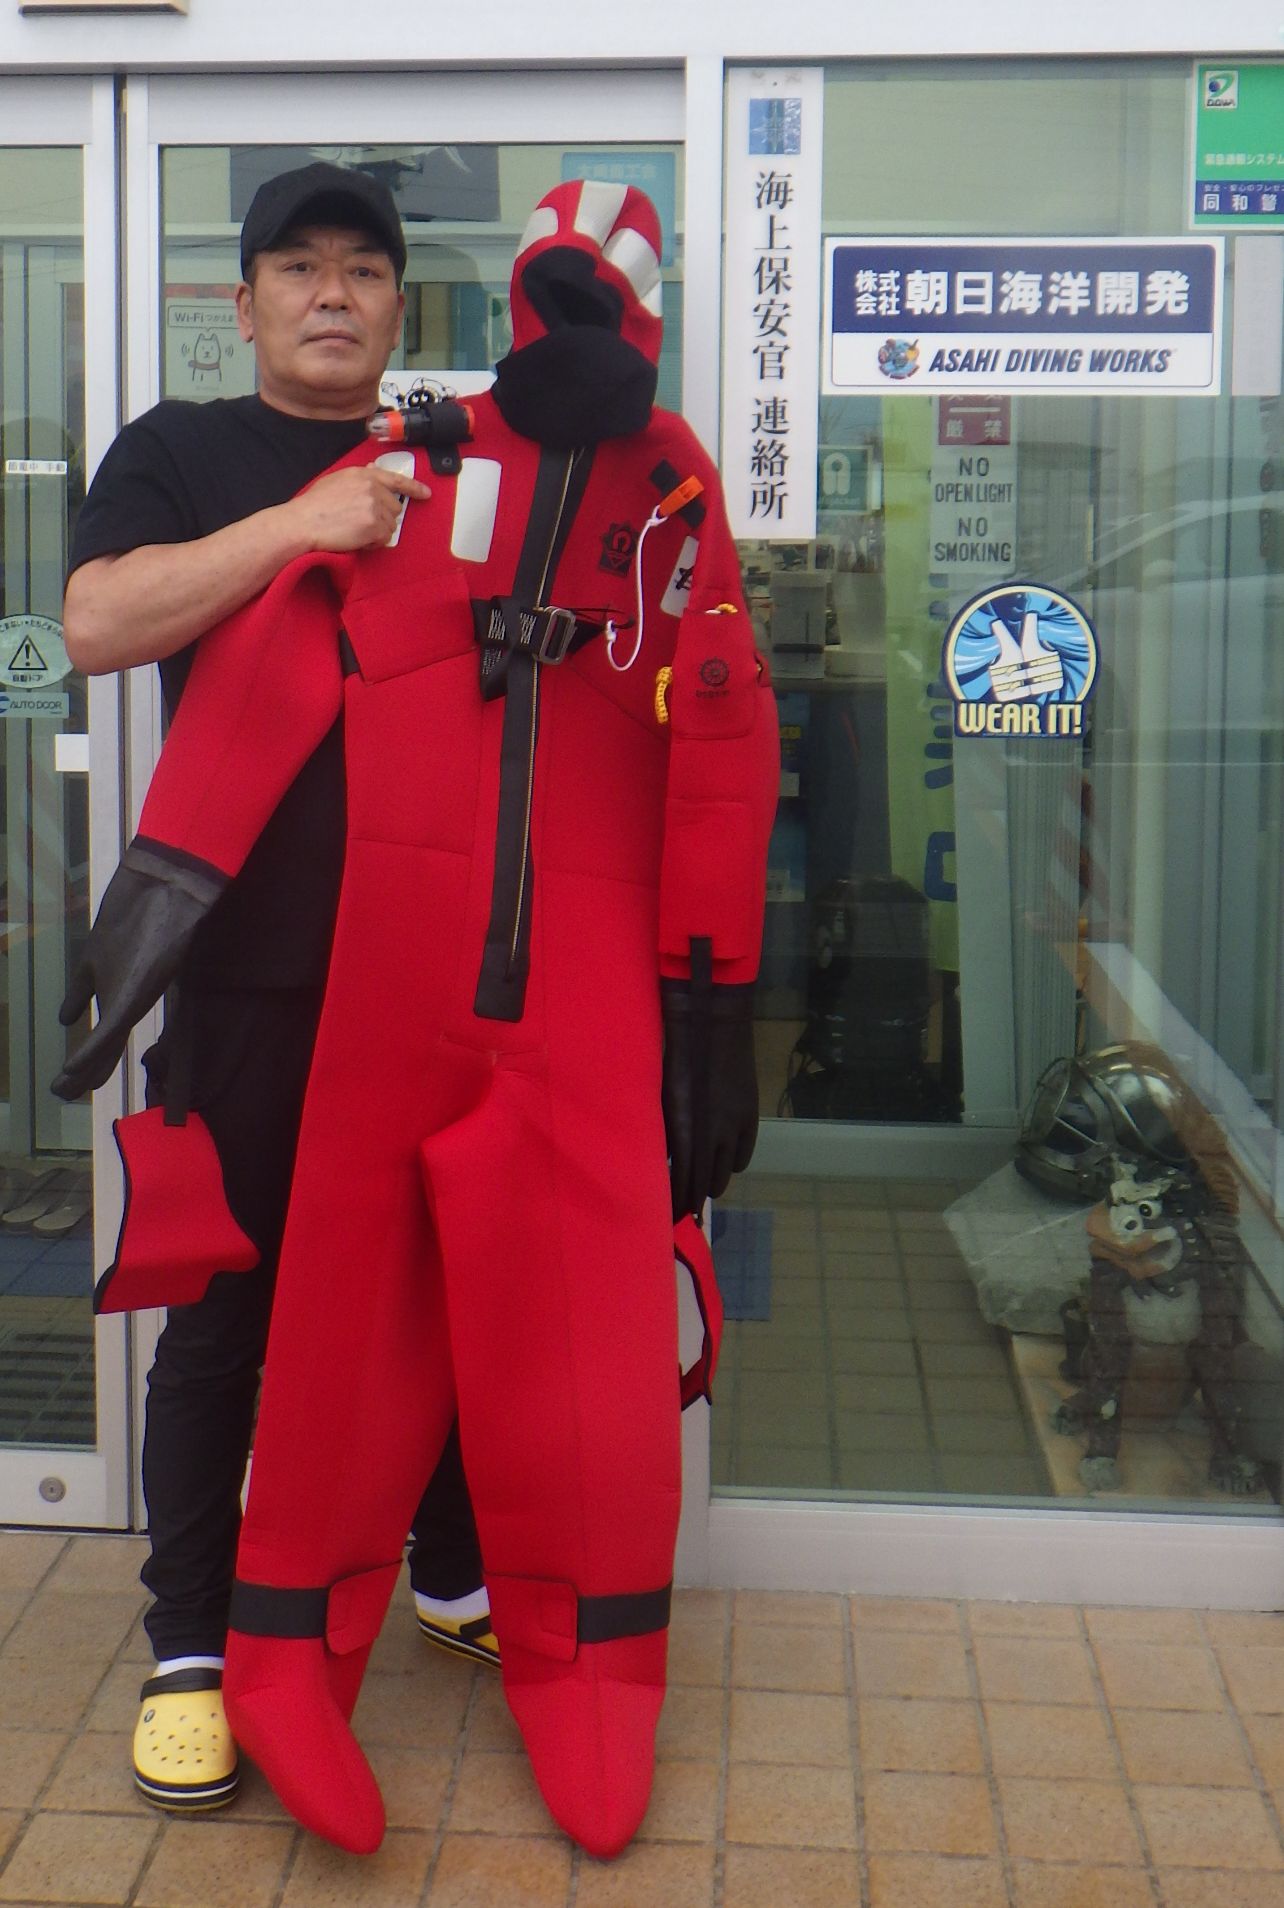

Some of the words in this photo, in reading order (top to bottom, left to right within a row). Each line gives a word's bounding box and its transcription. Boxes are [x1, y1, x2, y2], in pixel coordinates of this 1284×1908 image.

[752, 170, 794, 380] 海上保安官
[856, 269, 900, 292] 株式
[905, 269, 1190, 315] 朝日海洋開発
[856, 293, 900, 315] 会社
[928, 349, 1002, 372] ASAHI
[1005, 349, 1083, 372] DIVING
[1089, 349, 1172, 372] WORKS
[749, 396, 791, 520] 連絡所
[959, 457, 990, 477] NO
[934, 483, 973, 503] OPEN
[976, 483, 1013, 503] LIGHT
[958, 517, 989, 537] NO
[934, 542, 1012, 562] SMOKING
[958, 702, 1042, 734] WEAR
[1047, 702, 1082, 734] IT!
